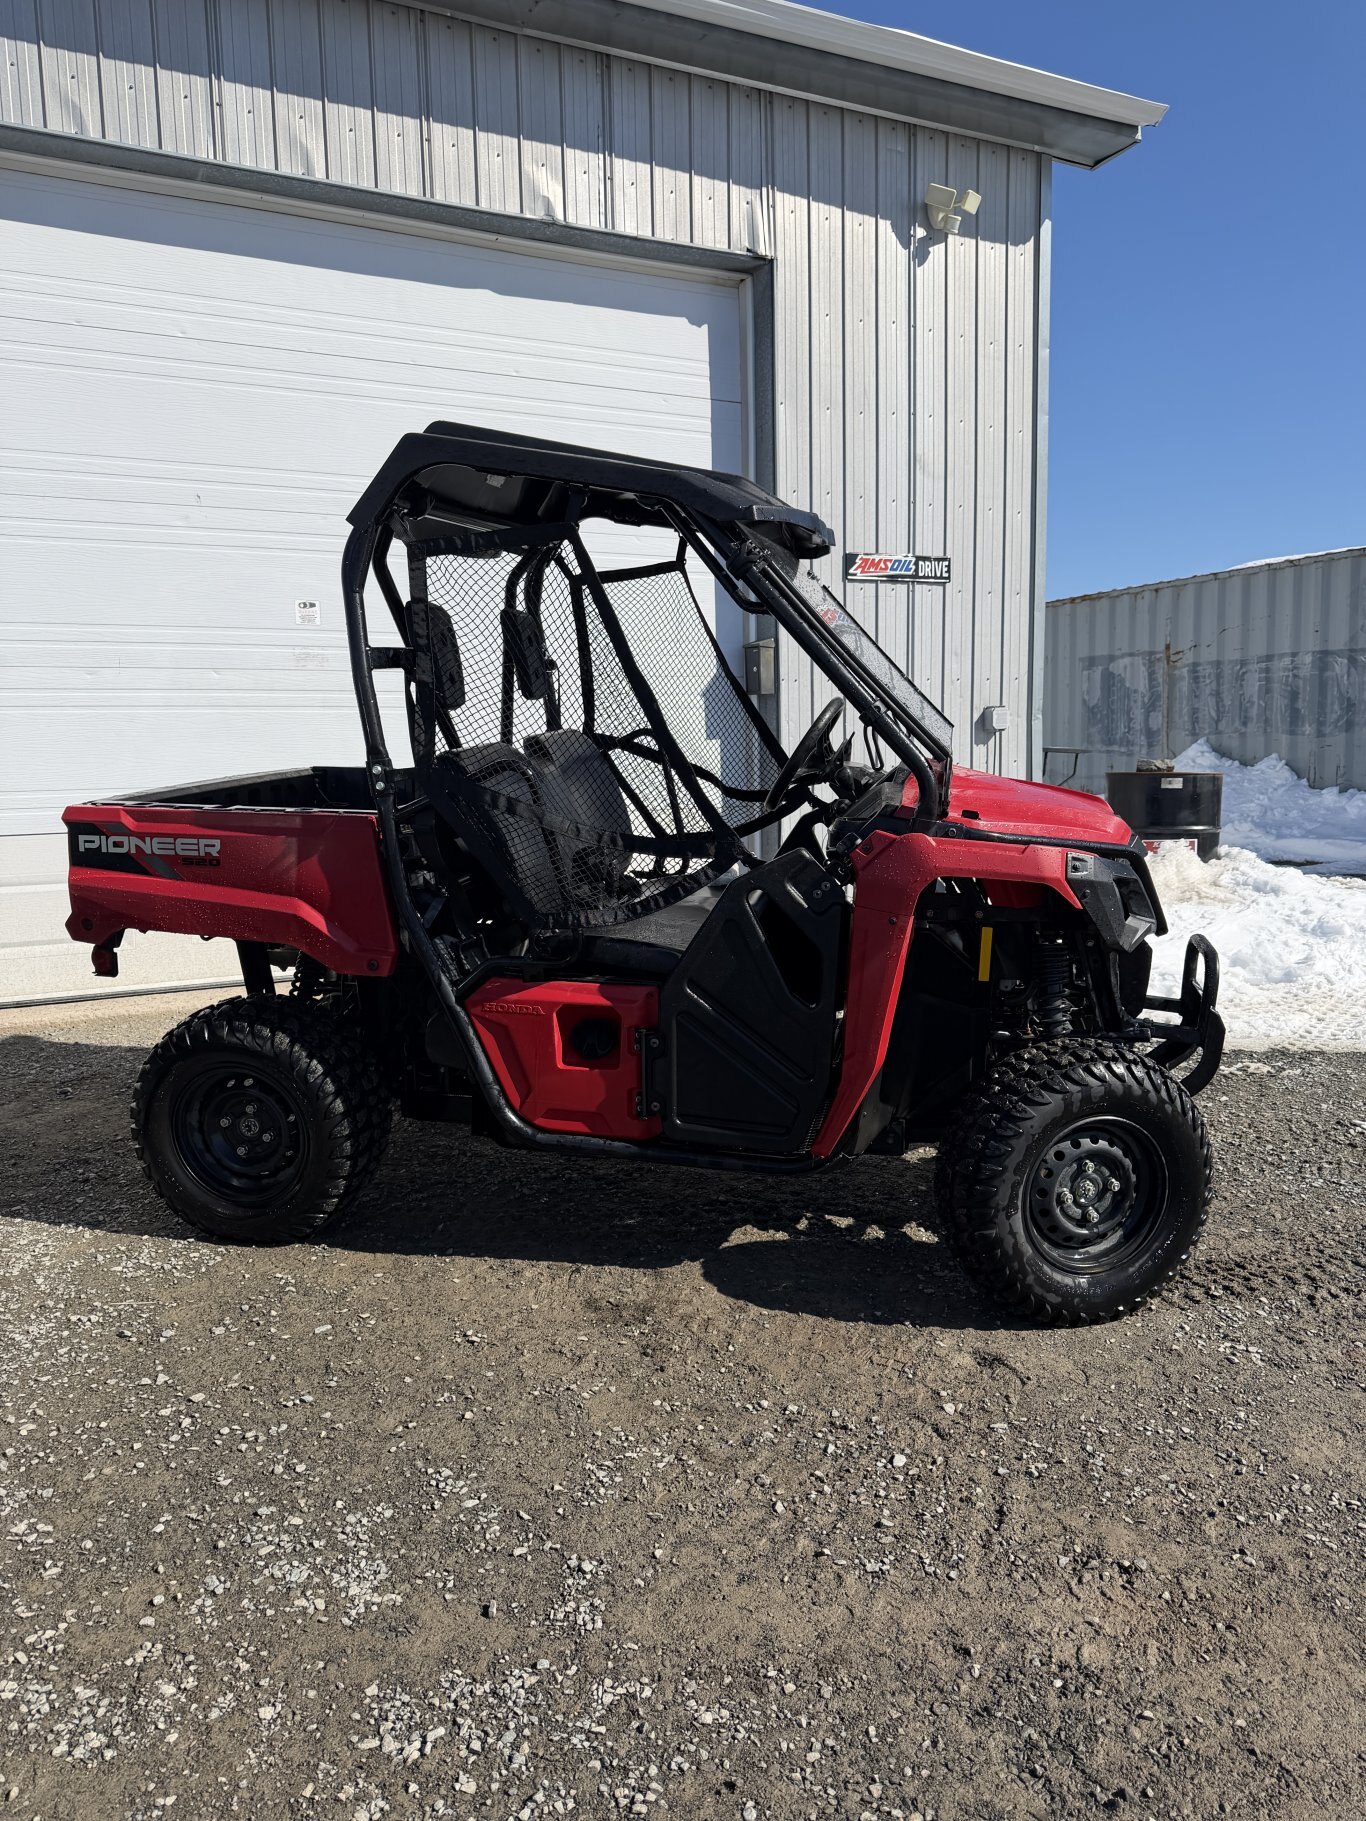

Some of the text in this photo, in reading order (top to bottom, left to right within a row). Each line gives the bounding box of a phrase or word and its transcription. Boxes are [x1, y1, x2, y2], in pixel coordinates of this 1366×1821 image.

[851, 556, 949, 577] AMSOIL DRIVE
[78, 834, 221, 857] PIONEER
[482, 1002, 546, 1015] HONDA
